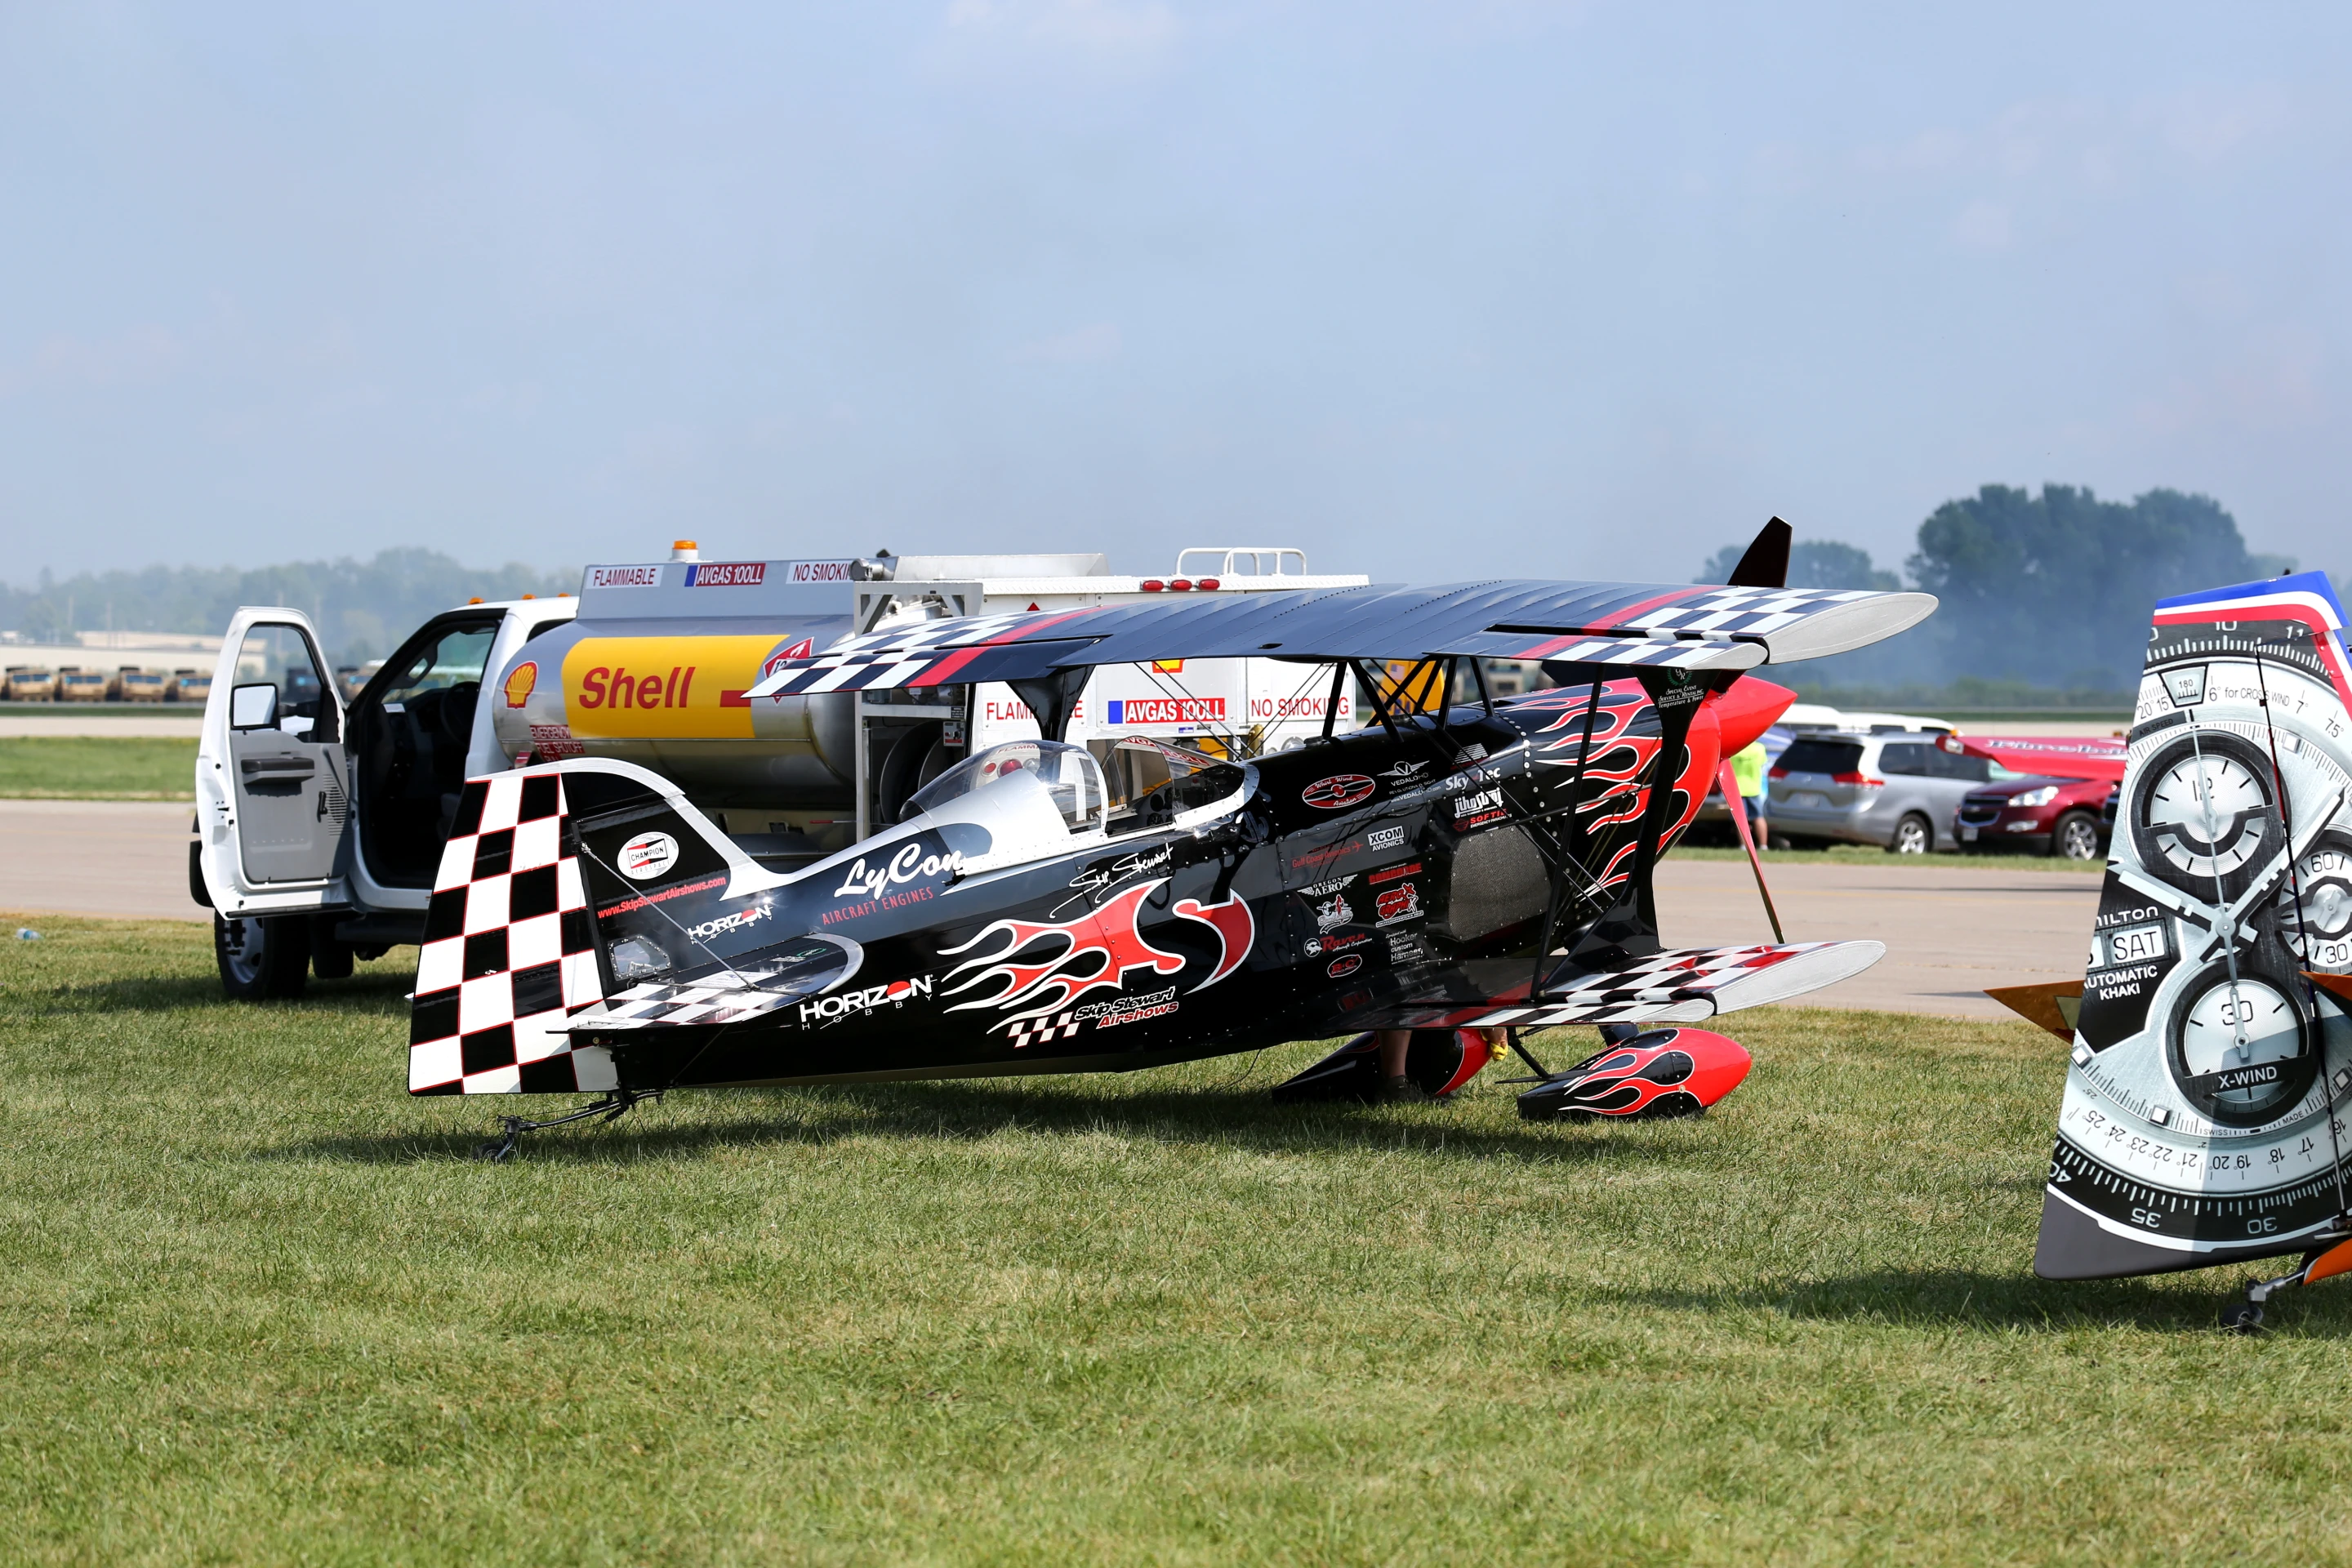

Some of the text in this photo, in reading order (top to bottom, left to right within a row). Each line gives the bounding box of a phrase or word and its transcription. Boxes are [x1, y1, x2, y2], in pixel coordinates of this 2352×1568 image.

[594, 568, 656, 586] FLAMMABLE
[697, 564, 762, 585] AVGAS 100LL
[793, 564, 850, 581] NO SMOKI
[579, 666, 696, 710] Shell
[2179, 679, 2193, 688] 180
[1251, 697, 1349, 717] NO SMOKIG
[2225, 688, 2238, 699] for
[2240, 688, 2270, 702] CROSS
[2271, 693, 2290, 707] WIND
[1126, 698, 1224, 722] AVGAS 100LL
[2139, 718, 2174, 737] AIR SPEED
[535, 742, 583, 754] FUEL SHUTOFF
[1315, 778, 1333, 789] Whirl
[1446, 776, 1469, 791] Sky
[1333, 796, 1357, 807] Aviation
[1370, 827, 1403, 844] XCOM
[630, 846, 664, 862] CHAMPION
[1372, 839, 1405, 852] AVIONICS
[630, 860, 671, 875] AEROSPACE
[1292, 858, 1306, 868] Gulf
[1307, 853, 1324, 864] Coast
[2310, 852, 2334, 872] 60
[834, 843, 962, 900] LyCon
[1369, 862, 1422, 884] CONCORDE
[1312, 876, 1342, 889] OREGON
[1314, 881, 1343, 898] AERO
[597, 876, 727, 918] www.SkipStewartAirshows.com
[822, 886, 934, 924] AIRCRAFT ENGINES
[688, 904, 773, 939] HORIZON
[1320, 933, 1365, 952] Raven
[1390, 933, 1418, 947] Hooker
[1391, 942, 1413, 953] custom
[2114, 931, 2157, 960] SAT
[2325, 943, 2348, 964] 30
[800, 974, 933, 1022] HORIZON
[2099, 982, 2140, 1000] KHAKI
[1075, 985, 1176, 1021] Skip Stewart
[1095, 1000, 1179, 1029] Airshows
[2221, 1000, 2253, 1026] 30
[2218, 1066, 2278, 1089] X-WIND
[2282, 1111, 2305, 1125] MADE
[2130, 1207, 2162, 1228] 35
[2247, 1217, 2278, 1235] 30
